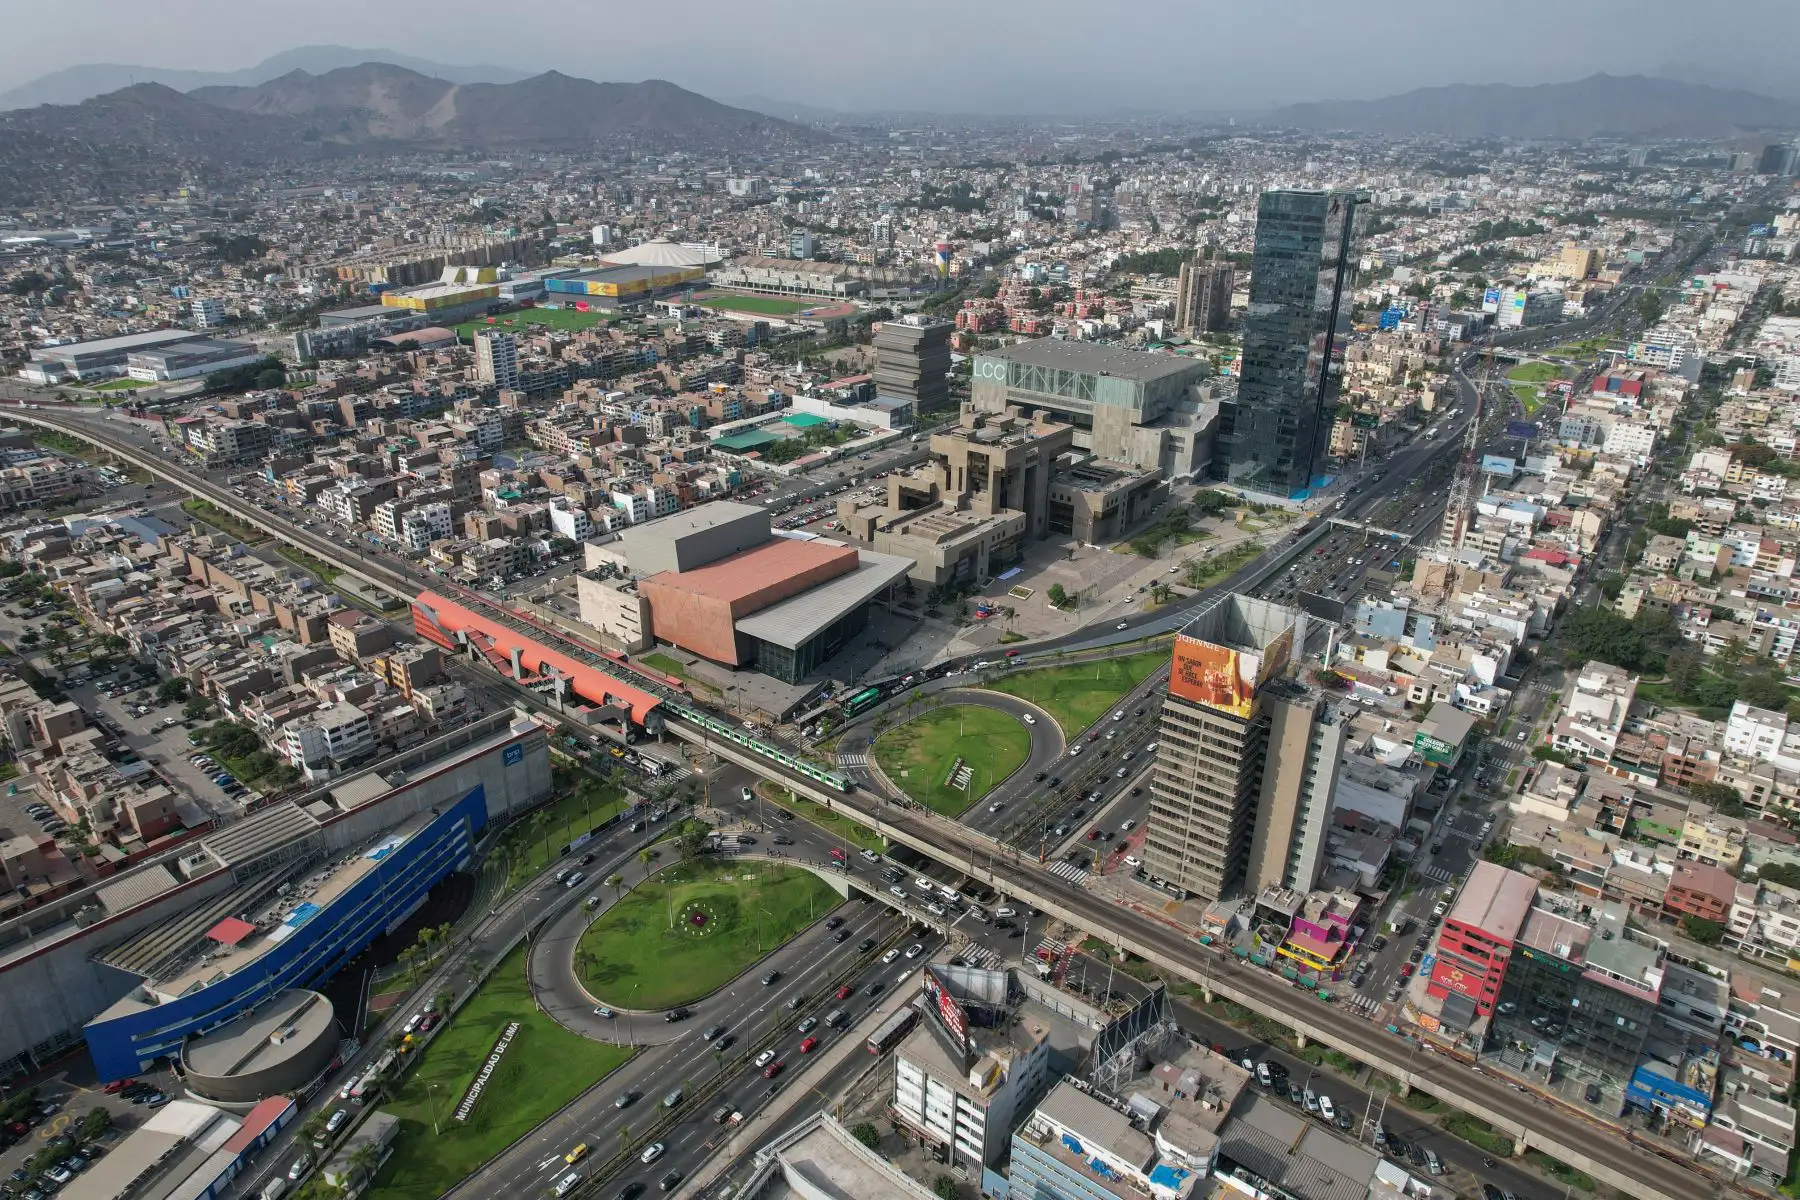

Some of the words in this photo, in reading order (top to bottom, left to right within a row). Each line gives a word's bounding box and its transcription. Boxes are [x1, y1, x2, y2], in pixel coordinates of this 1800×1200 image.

[974, 360, 1005, 380] LCC
[1176, 633, 1220, 652] JOHNNIE
[952, 765, 975, 791] LIMA
[456, 1054, 500, 1121] MUNICIPALIDAD
[495, 1041, 508, 1054] DE
[502, 1022, 520, 1042] LIMA
